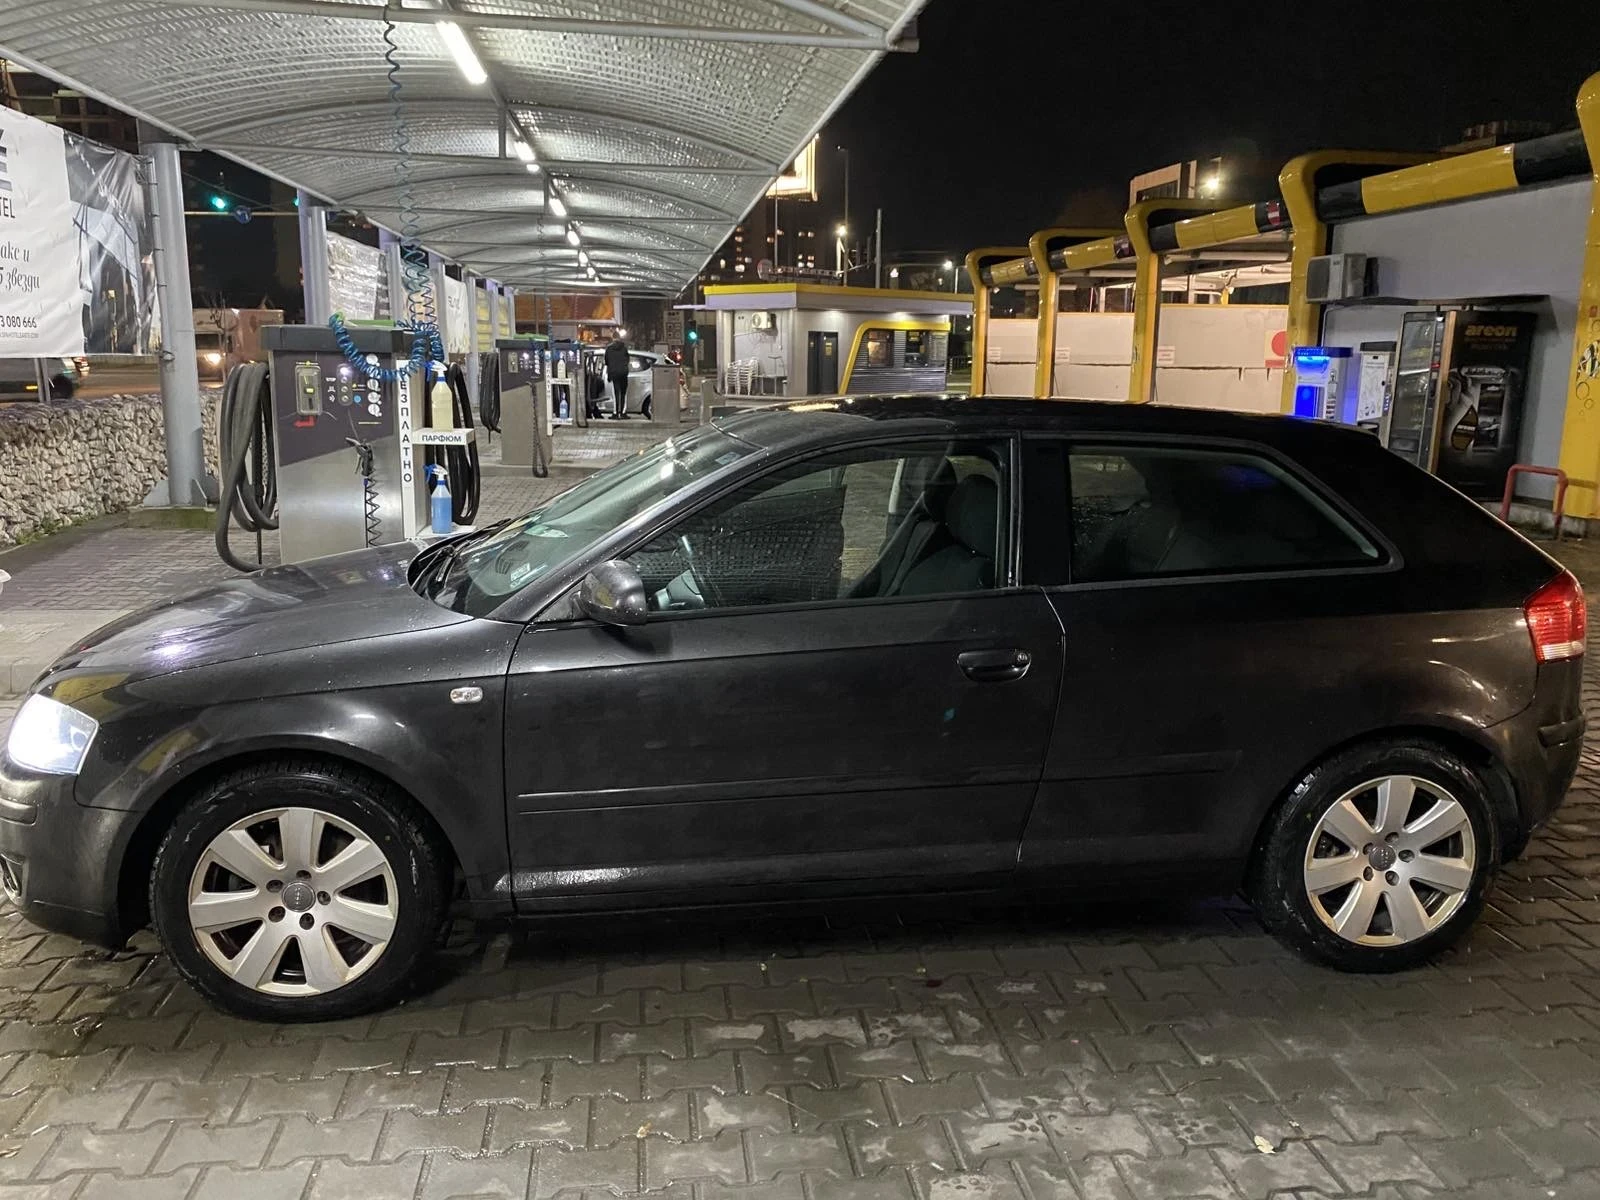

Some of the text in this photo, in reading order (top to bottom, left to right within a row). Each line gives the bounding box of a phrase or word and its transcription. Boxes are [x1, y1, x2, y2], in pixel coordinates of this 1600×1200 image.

[6, 267, 40, 293] звезди
[6, 315, 21, 328] 080
[23, 317, 37, 329] 666
[1465, 324, 1518, 337] areon
[422, 434, 462, 443] ПАРФЮМ
